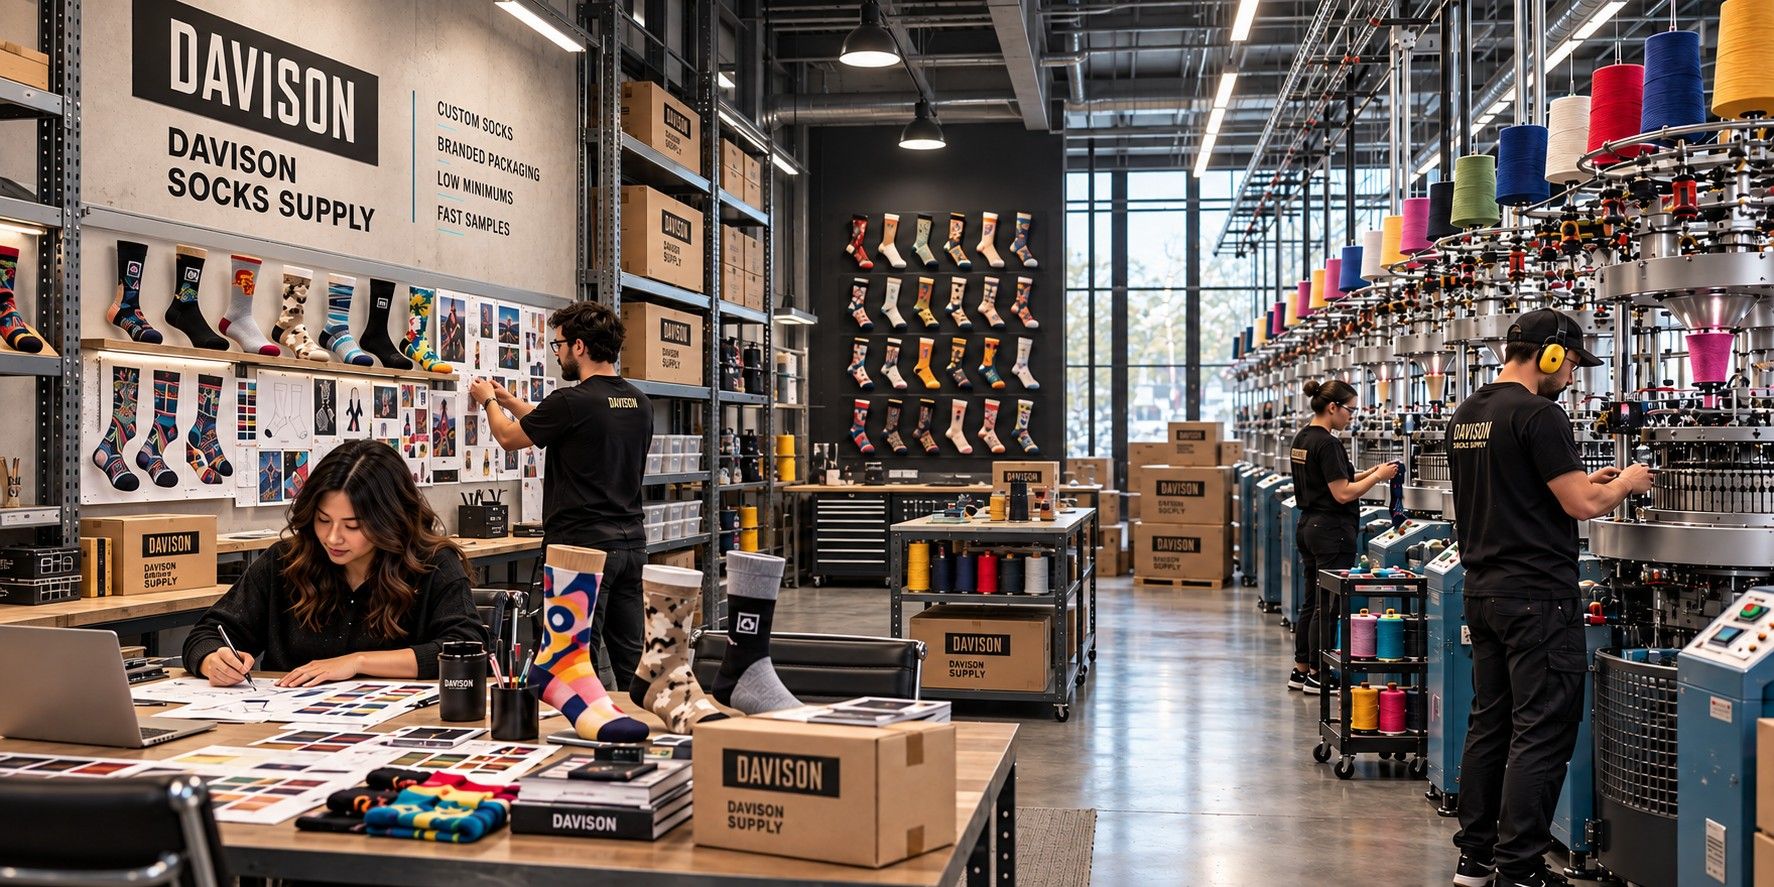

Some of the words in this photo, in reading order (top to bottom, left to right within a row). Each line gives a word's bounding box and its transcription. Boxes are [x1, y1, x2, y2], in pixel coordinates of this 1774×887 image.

[170, 18, 355, 143] DAVISON
[437, 100, 480, 129] CUSTOM
[482, 117, 514, 141] SOCKS
[168, 126, 296, 183] DAVISON
[437, 135, 486, 165] BRANDED
[488, 152, 540, 182] PACKAGING
[437, 170, 460, 190] LOW
[463, 177, 514, 205] MINIMUMS
[167, 167, 270, 213] SOCKS
[278, 190, 376, 233] SUPPLY
[437, 205, 463, 225] FAST
[465, 212, 510, 237] SAMPLES
[1453, 421, 1493, 440] DAVISON
[1161, 482, 1199, 495] DAVISON
[149, 534, 191, 554] DAVISON
[1157, 538, 1195, 552] DAVISON
[144, 562, 177, 572] DAVISON
[144, 577, 178, 589] SUPPLY
[953, 636, 1002, 653] DAVISON
[949, 660, 984, 669] DAVISON
[949, 669, 986, 678] SUPPLY
[444, 679, 474, 688] DAVISON
[737, 755, 822, 791] DAVISON
[727, 800, 784, 819] DAVISON
[553, 813, 617, 832] DAVISON
[727, 816, 783, 834] SUPPLY
